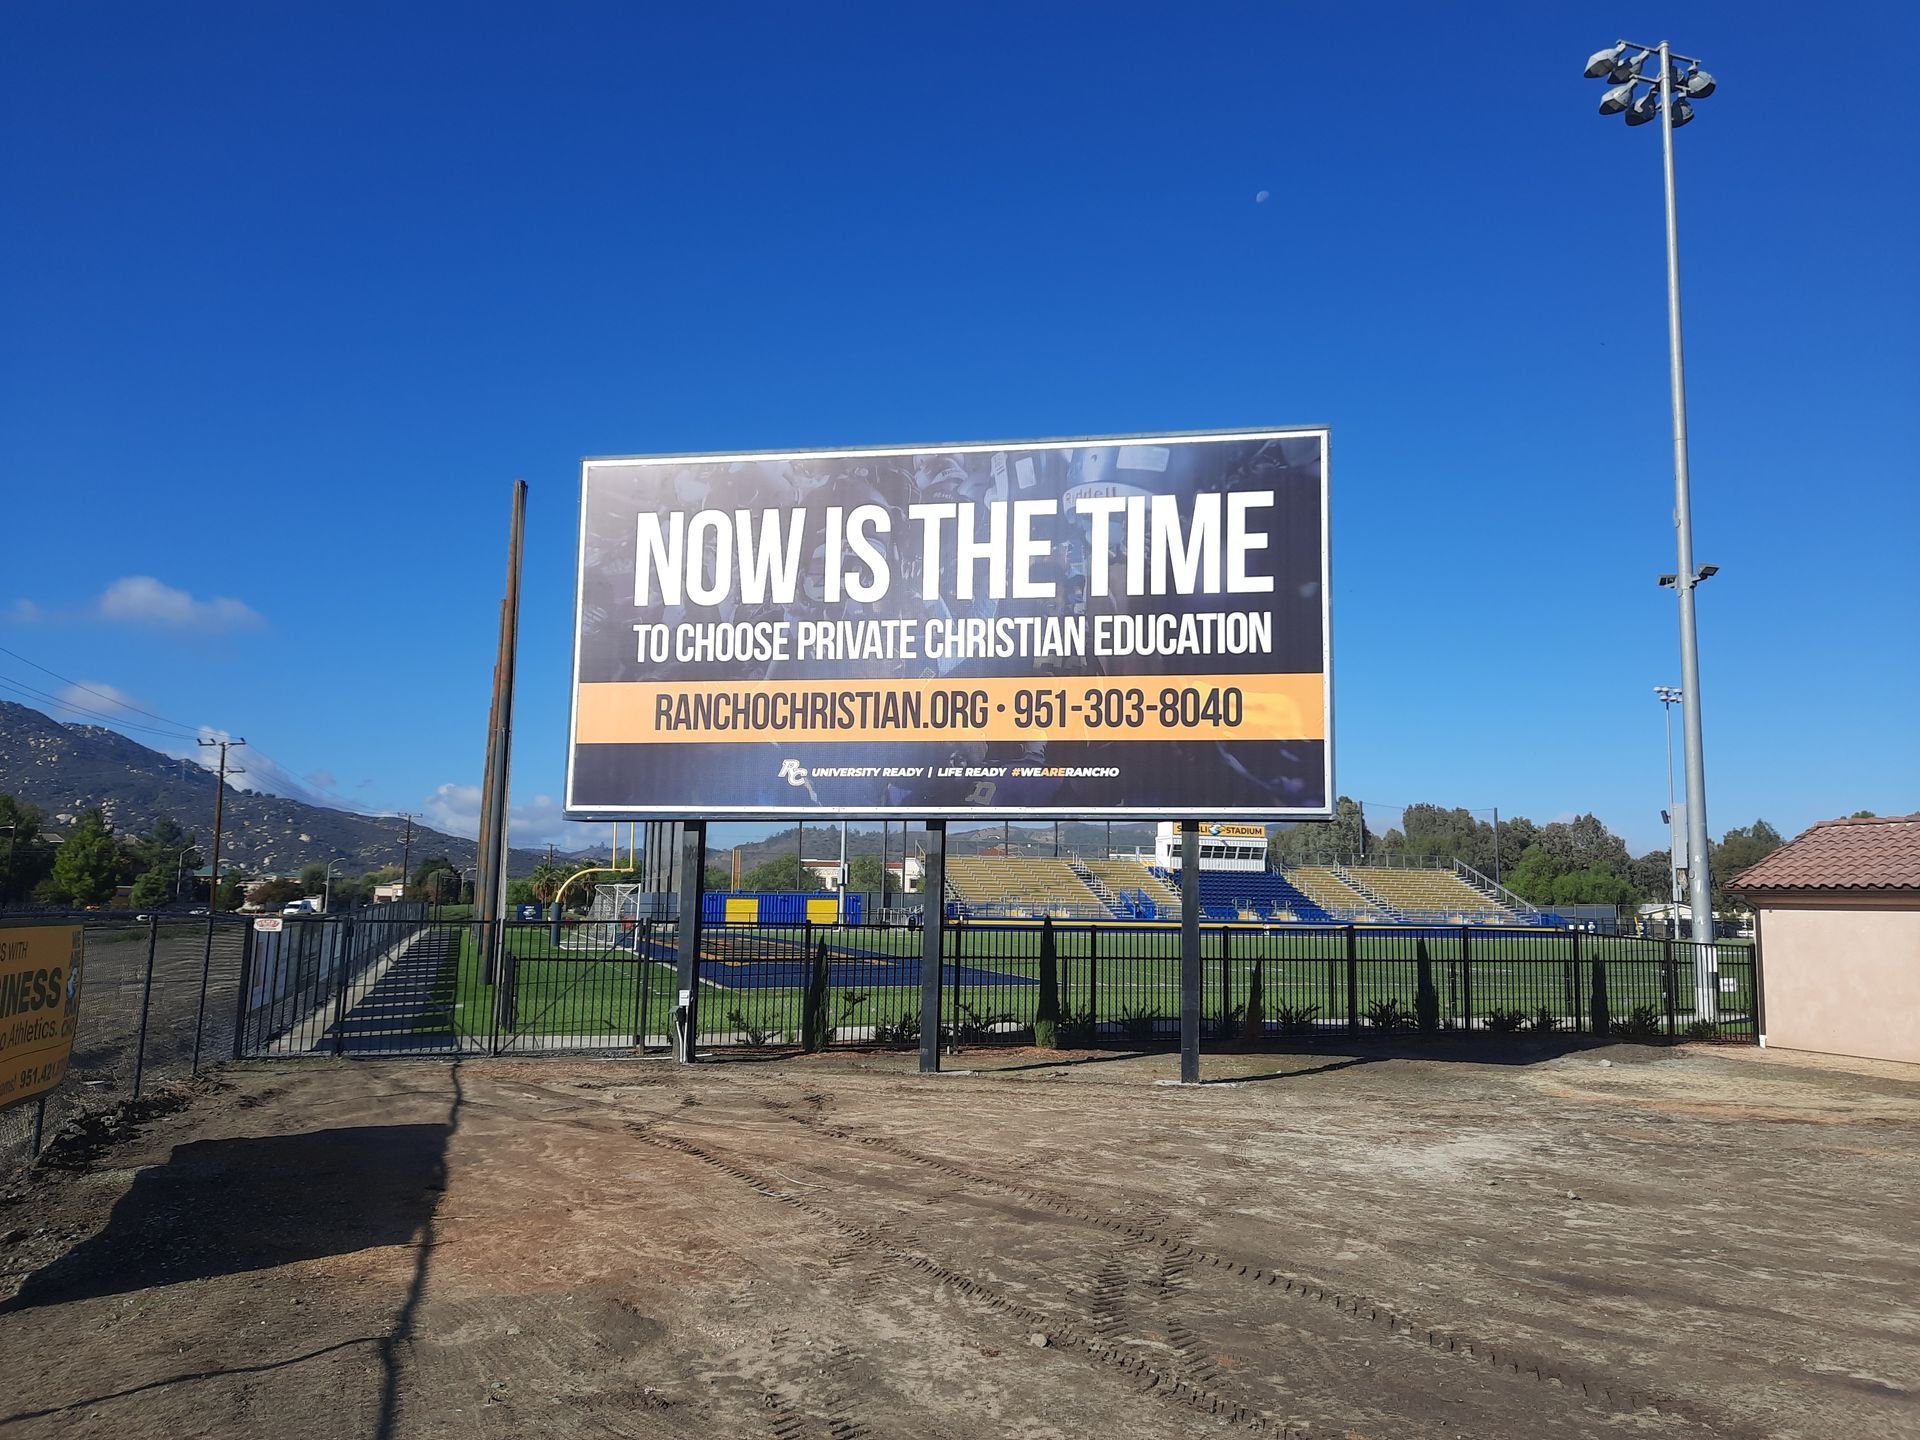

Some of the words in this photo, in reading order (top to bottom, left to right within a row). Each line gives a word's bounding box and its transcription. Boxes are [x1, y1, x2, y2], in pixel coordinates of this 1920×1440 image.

[633, 507, 806, 607] NOW
[823, 504, 891, 603] IS
[908, 501, 1058, 601] THE
[1075, 490, 1275, 597] TIME
[633, 623, 670, 663] TO
[675, 621, 790, 663] CHOOSE
[797, 619, 917, 661] PRIVATE
[924, 615, 1085, 659] CHRISTIAN
[1094, 611, 1272, 657] EDUCATION
[655, 689, 988, 731] RANCHOCHRISTIAN.ORG
[1014, 686, 1243, 729] 951-303-8040
[812, 767, 880, 778] UNIVERSITY
[882, 767, 924, 777] READY
[937, 767, 964, 778] LIFE
[965, 767, 1007, 777] READY
[1011, 767, 1120, 778] #WEARERANCHO
[1226, 827, 1263, 835] STADIUM
[8, 941, 29, 960] WITH
[7, 1017, 58, 1048] Athletics.
